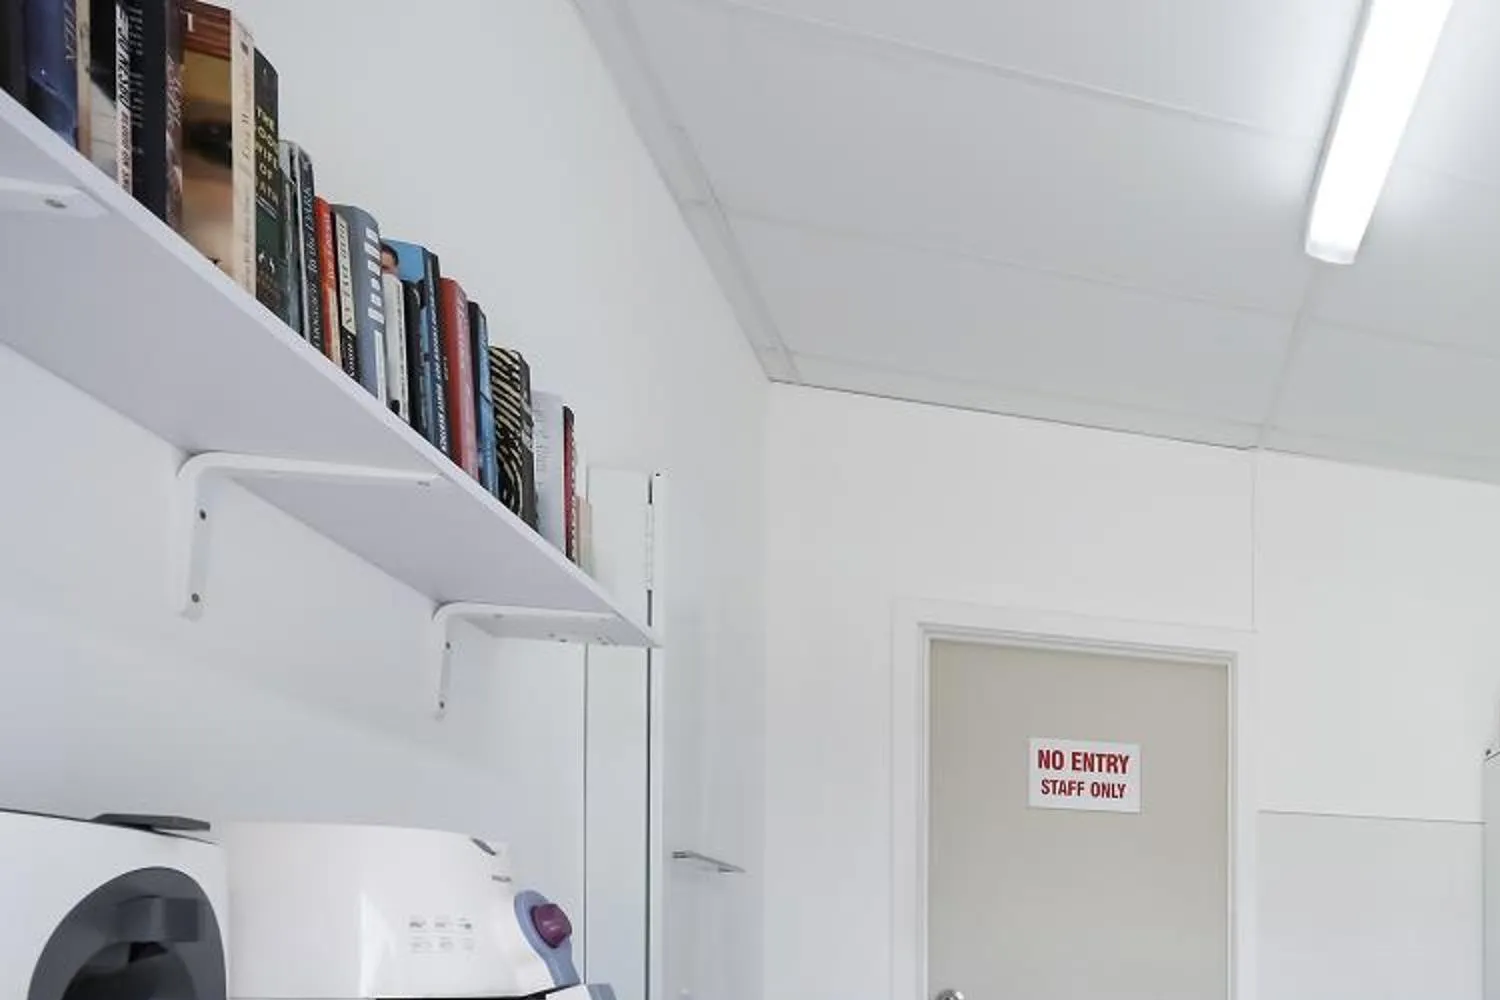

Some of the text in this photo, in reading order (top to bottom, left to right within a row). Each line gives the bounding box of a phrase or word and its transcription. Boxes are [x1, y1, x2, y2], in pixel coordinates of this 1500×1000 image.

[1037, 749, 1129, 774] NO ENTRY
[1041, 779, 1126, 799] STAFF ONLY
